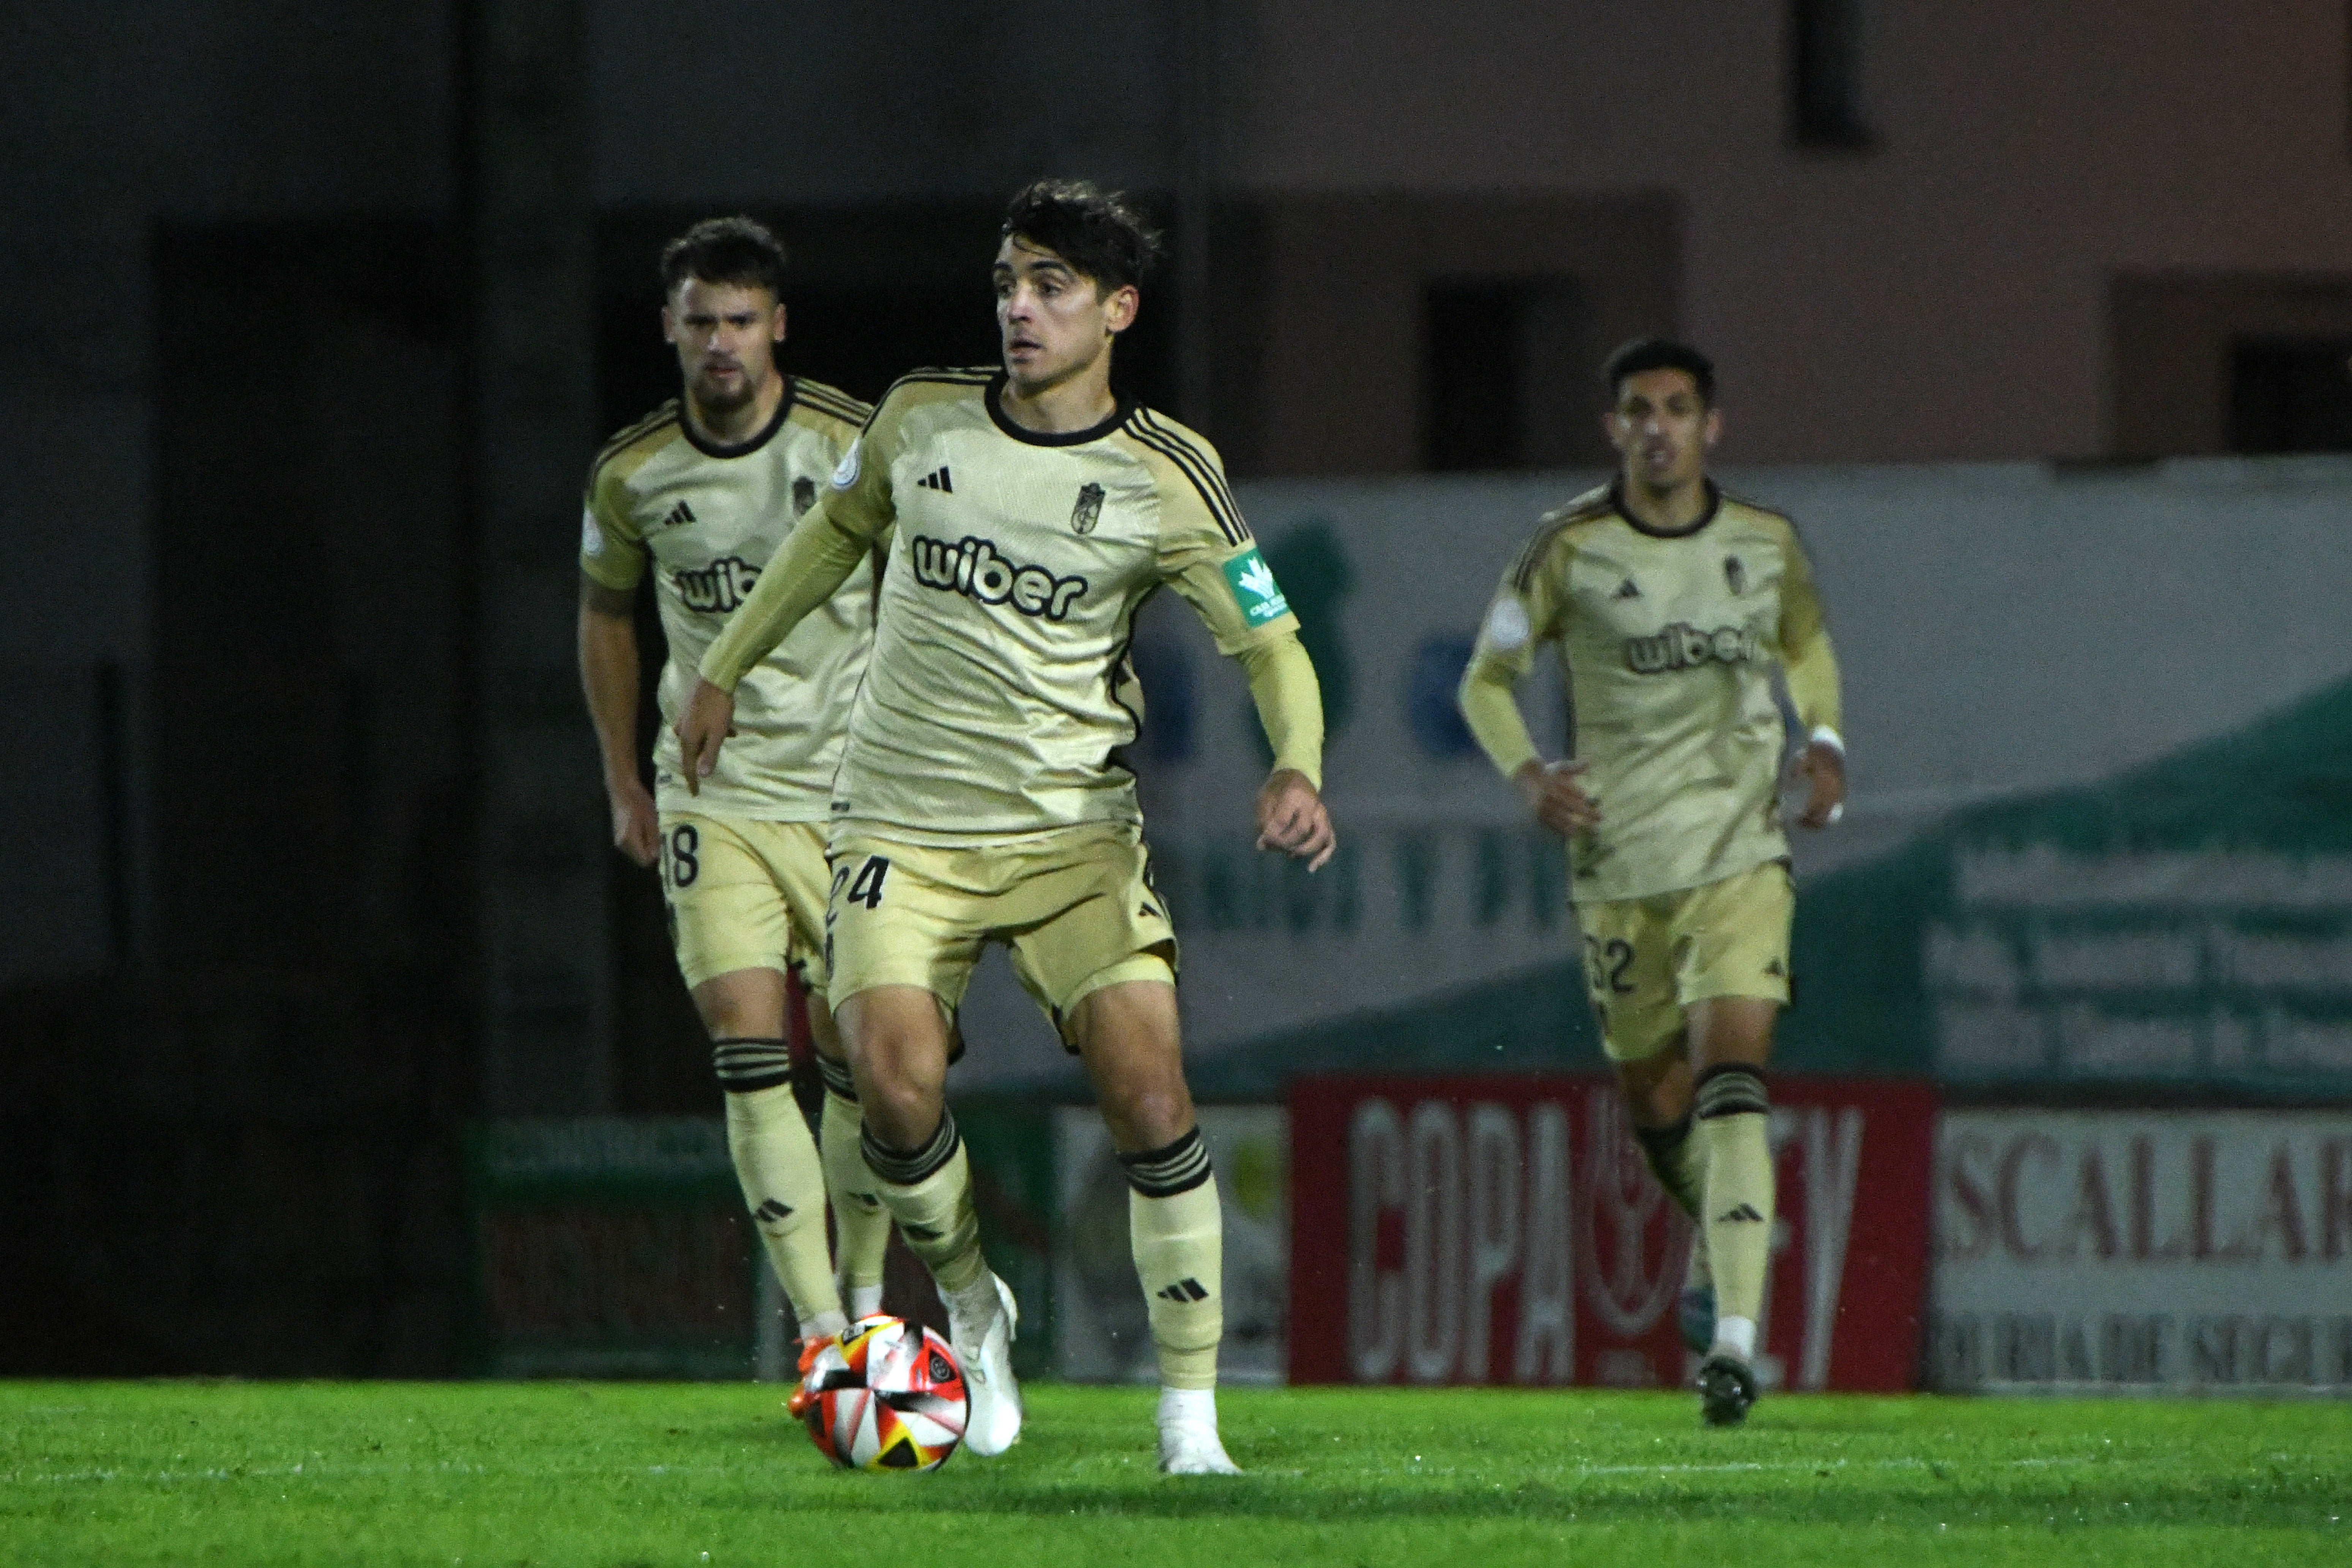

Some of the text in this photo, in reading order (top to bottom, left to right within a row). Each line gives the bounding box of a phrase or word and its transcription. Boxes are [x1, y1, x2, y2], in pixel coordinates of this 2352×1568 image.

[676, 556, 761, 612] wib
[912, 535, 1089, 621] wiber
[1348, 1098, 1575, 1383] COPA
